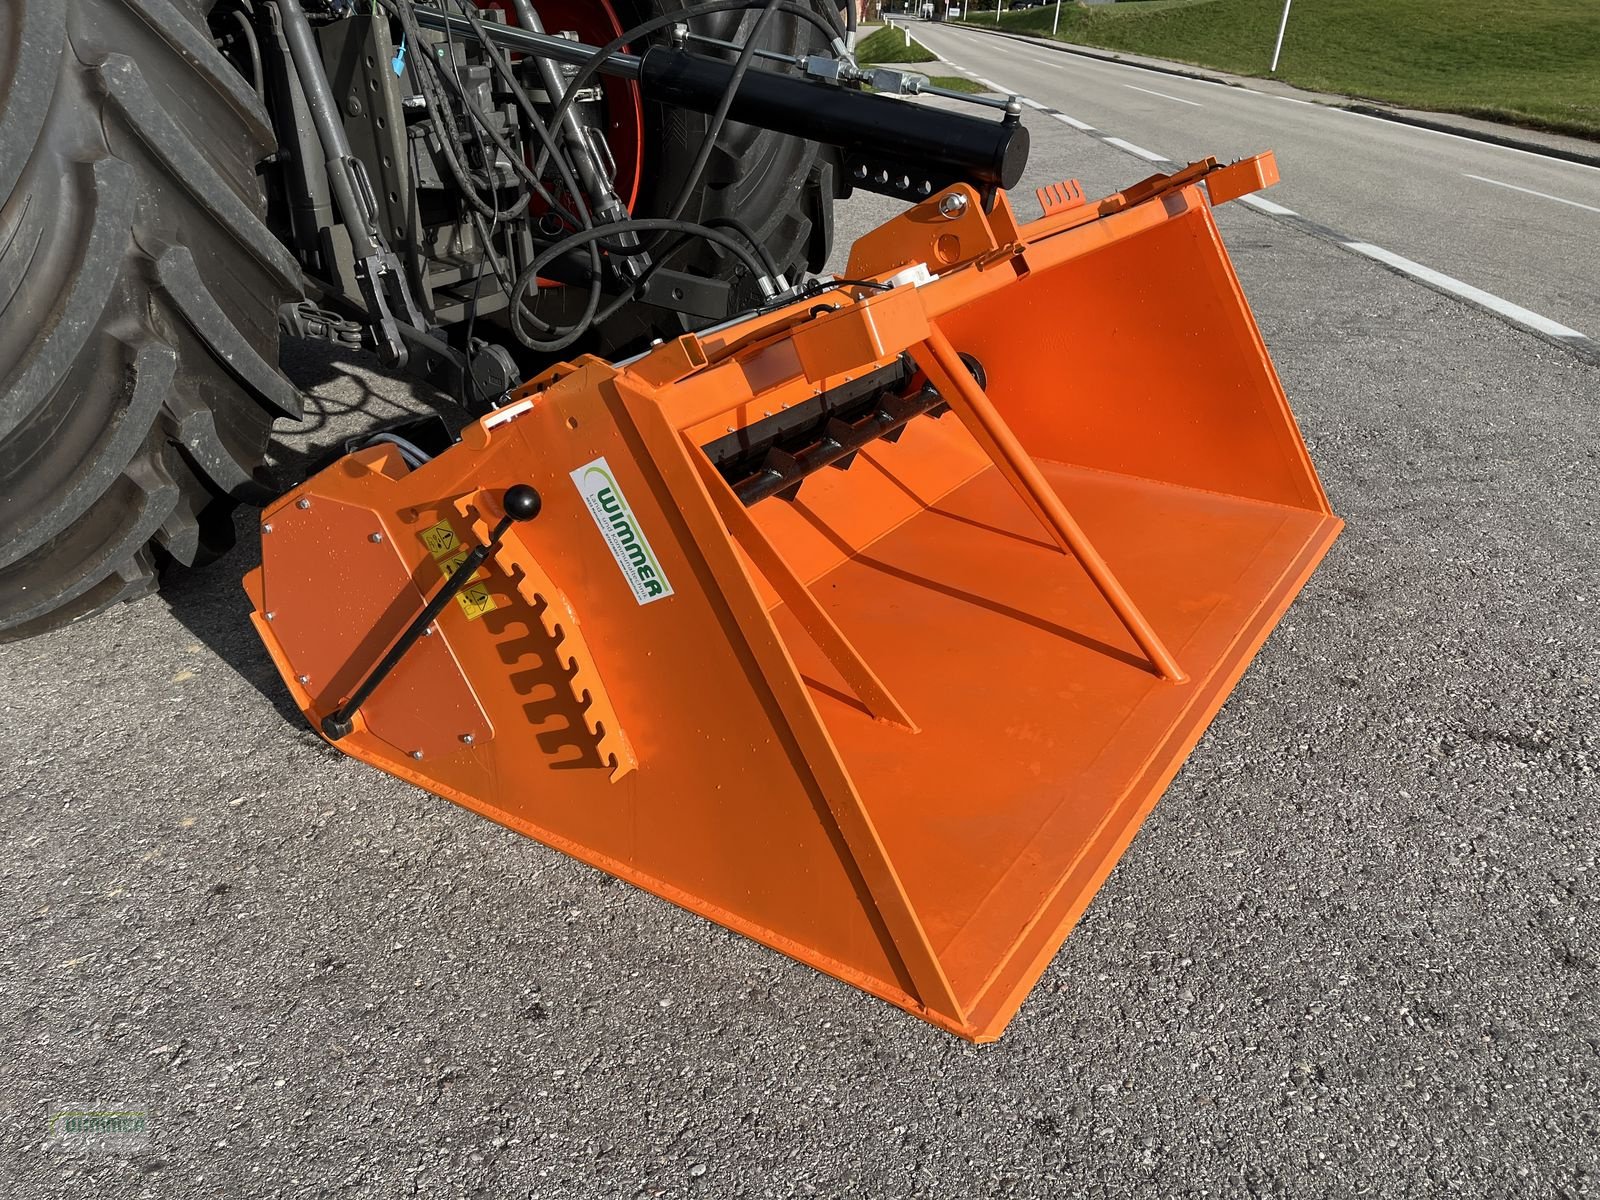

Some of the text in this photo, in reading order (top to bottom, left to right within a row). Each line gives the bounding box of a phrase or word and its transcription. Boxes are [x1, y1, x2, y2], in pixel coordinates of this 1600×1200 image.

[597, 487, 663, 598] WIMMER
[602, 517, 613, 533] und
[611, 533, 648, 599] Kommunaltechnik
